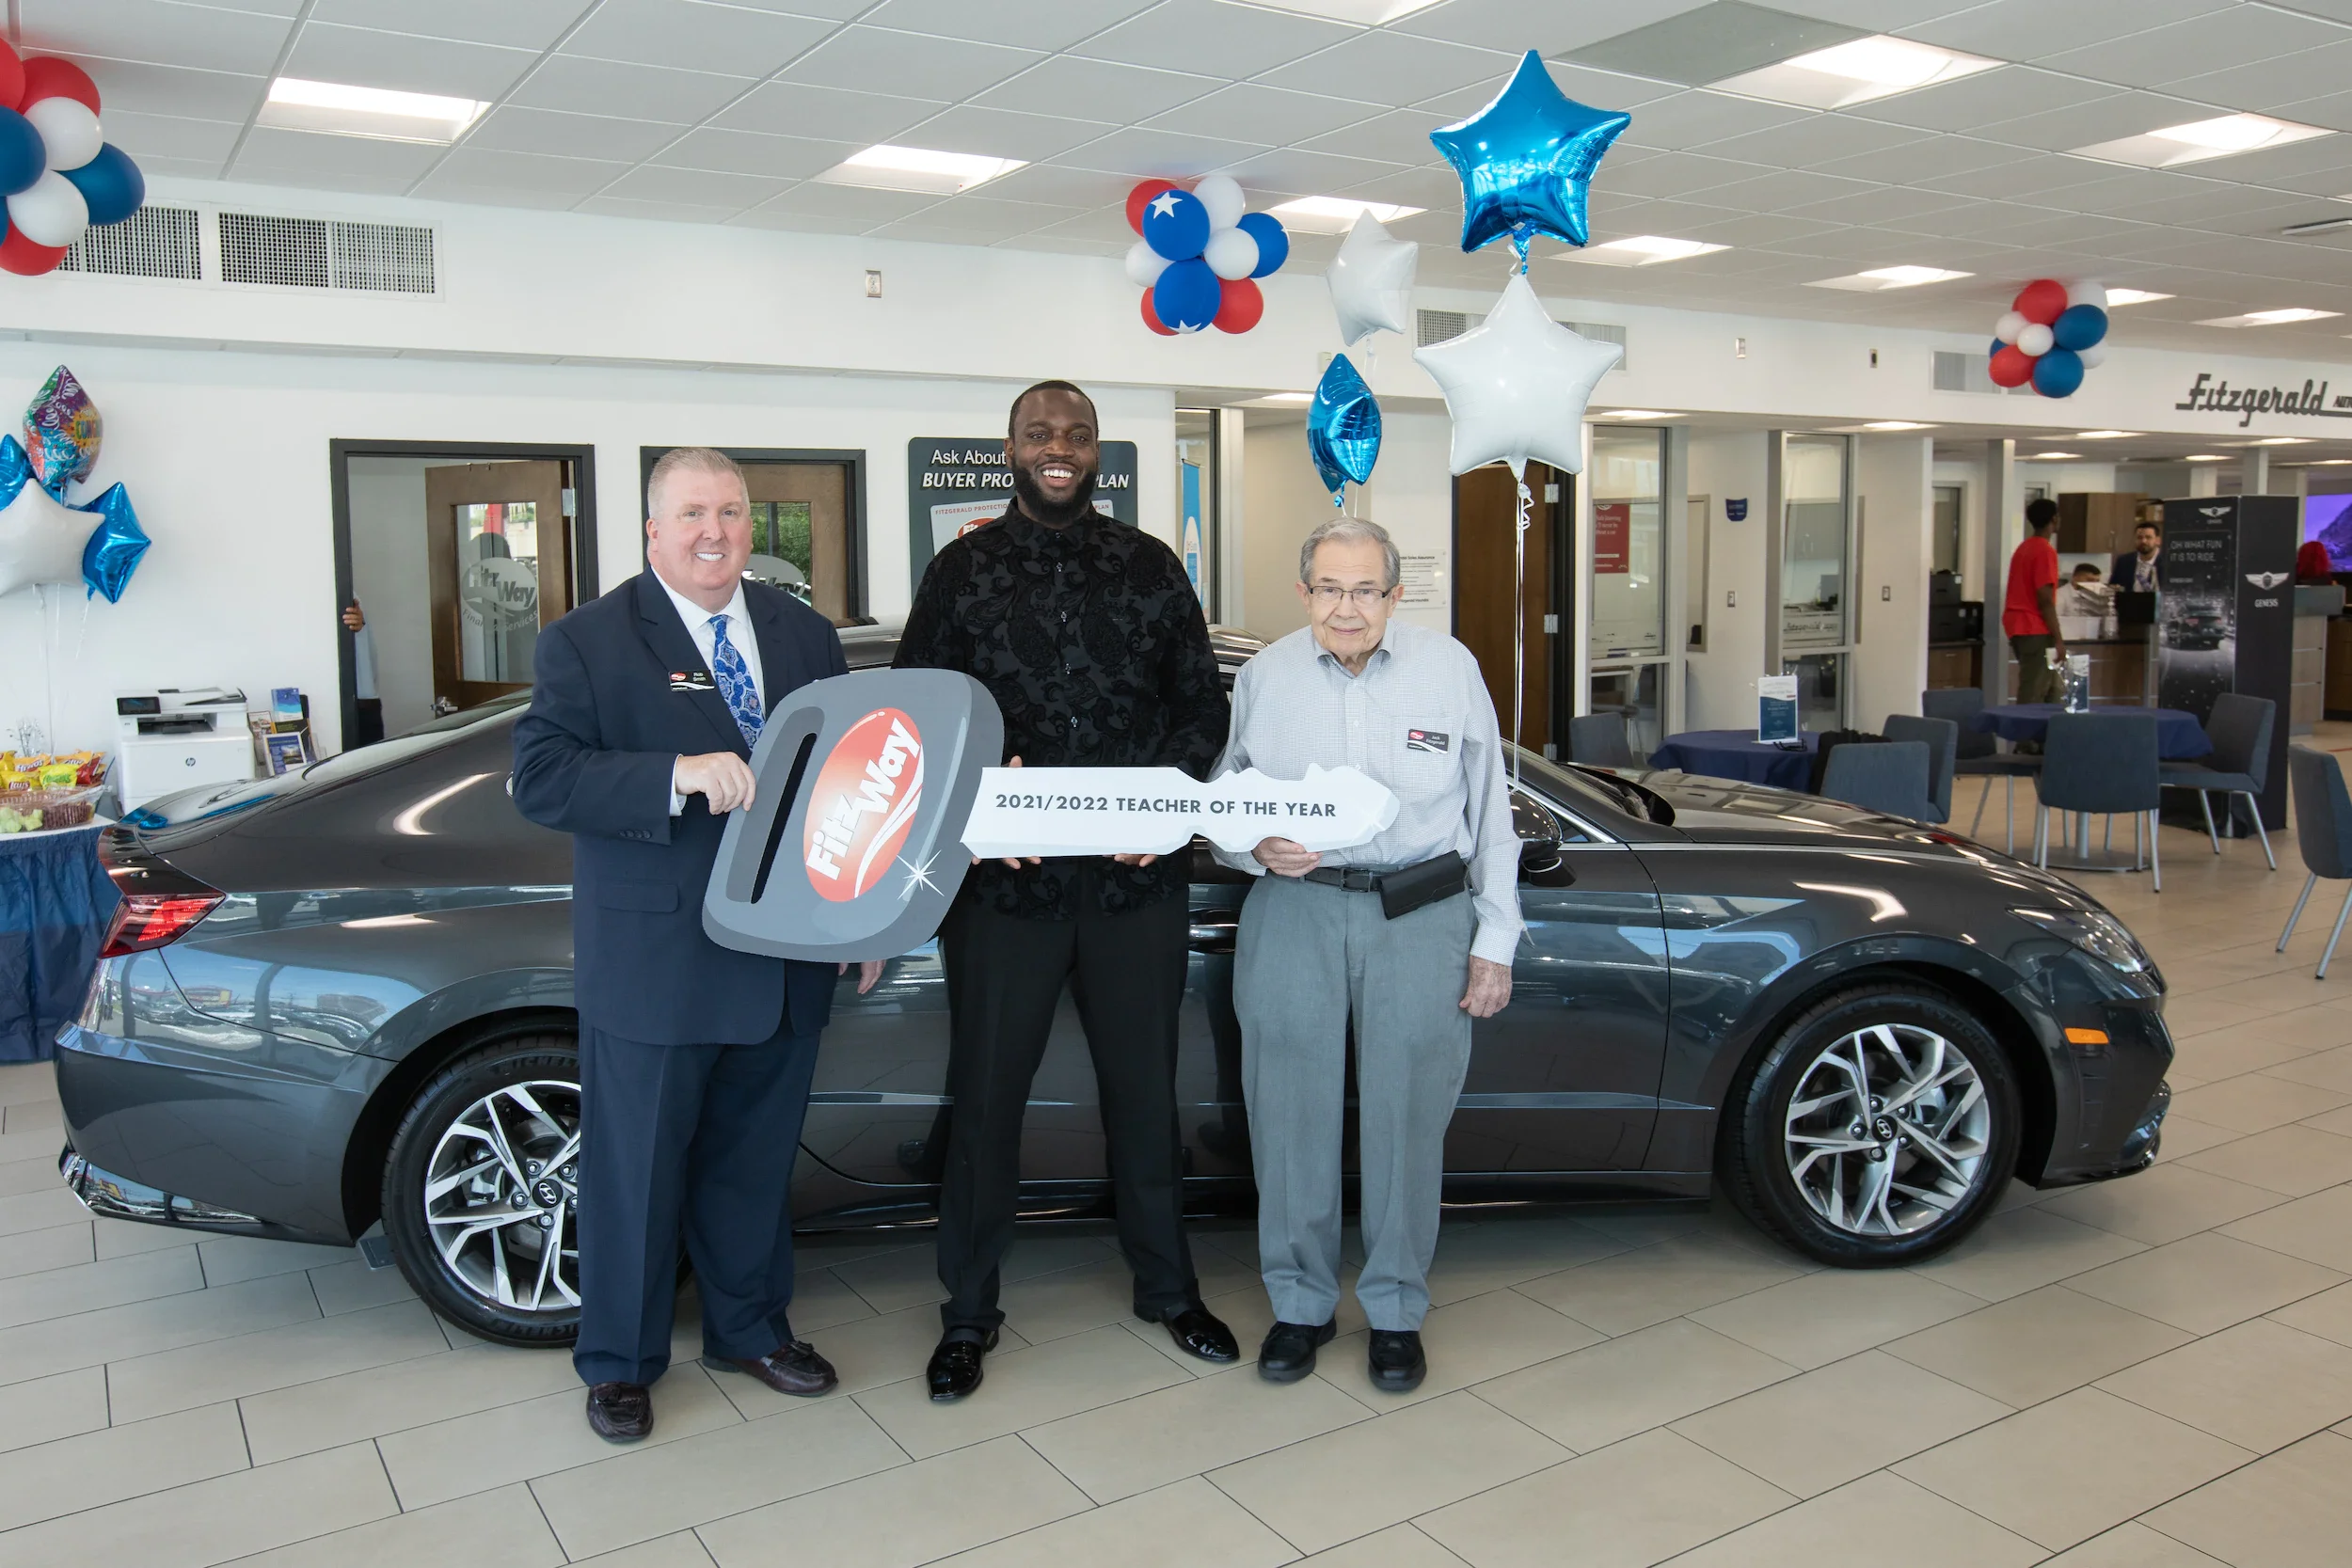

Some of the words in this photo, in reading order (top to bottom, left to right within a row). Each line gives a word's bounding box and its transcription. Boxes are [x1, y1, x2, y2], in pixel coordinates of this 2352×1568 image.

[2175, 373, 2328, 428] Fitzgerald
[931, 450, 960, 466] Ask
[963, 450, 1007, 466] About
[922, 472, 976, 488] BUYER
[981, 473, 1015, 488] PRO
[1096, 473, 1130, 488] LAN
[935, 506, 973, 515] FITZGERALD
[974, 503, 1009, 512] PROTECTIO
[2254, 598, 2279, 608] GENESIS
[995, 794, 1108, 812] 2021/2022
[1116, 798, 1201, 814] TEACHER
[1210, 800, 1236, 814] OF
[1243, 801, 1277, 816] THE
[1285, 801, 1337, 817] YEAR
